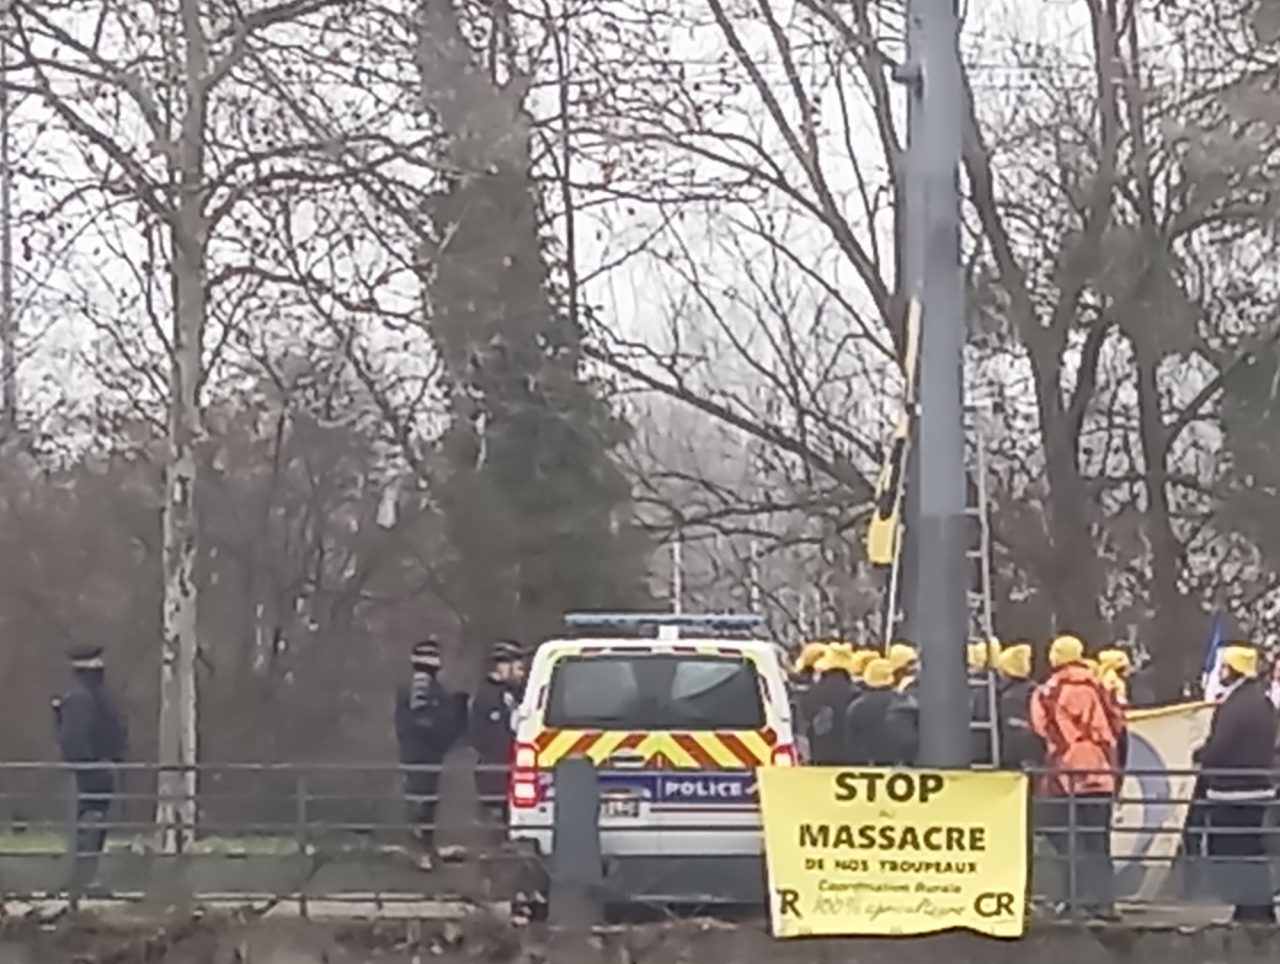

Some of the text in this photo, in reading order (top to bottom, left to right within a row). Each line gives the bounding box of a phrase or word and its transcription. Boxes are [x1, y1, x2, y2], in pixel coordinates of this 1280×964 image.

[664, 781, 742, 796] POLICE
[835, 772, 944, 803] STOP
[799, 824, 985, 851] MASSACRE
[805, 858, 977, 874] DE NOS TROUPEAUX
[973, 892, 1017, 917] CR
